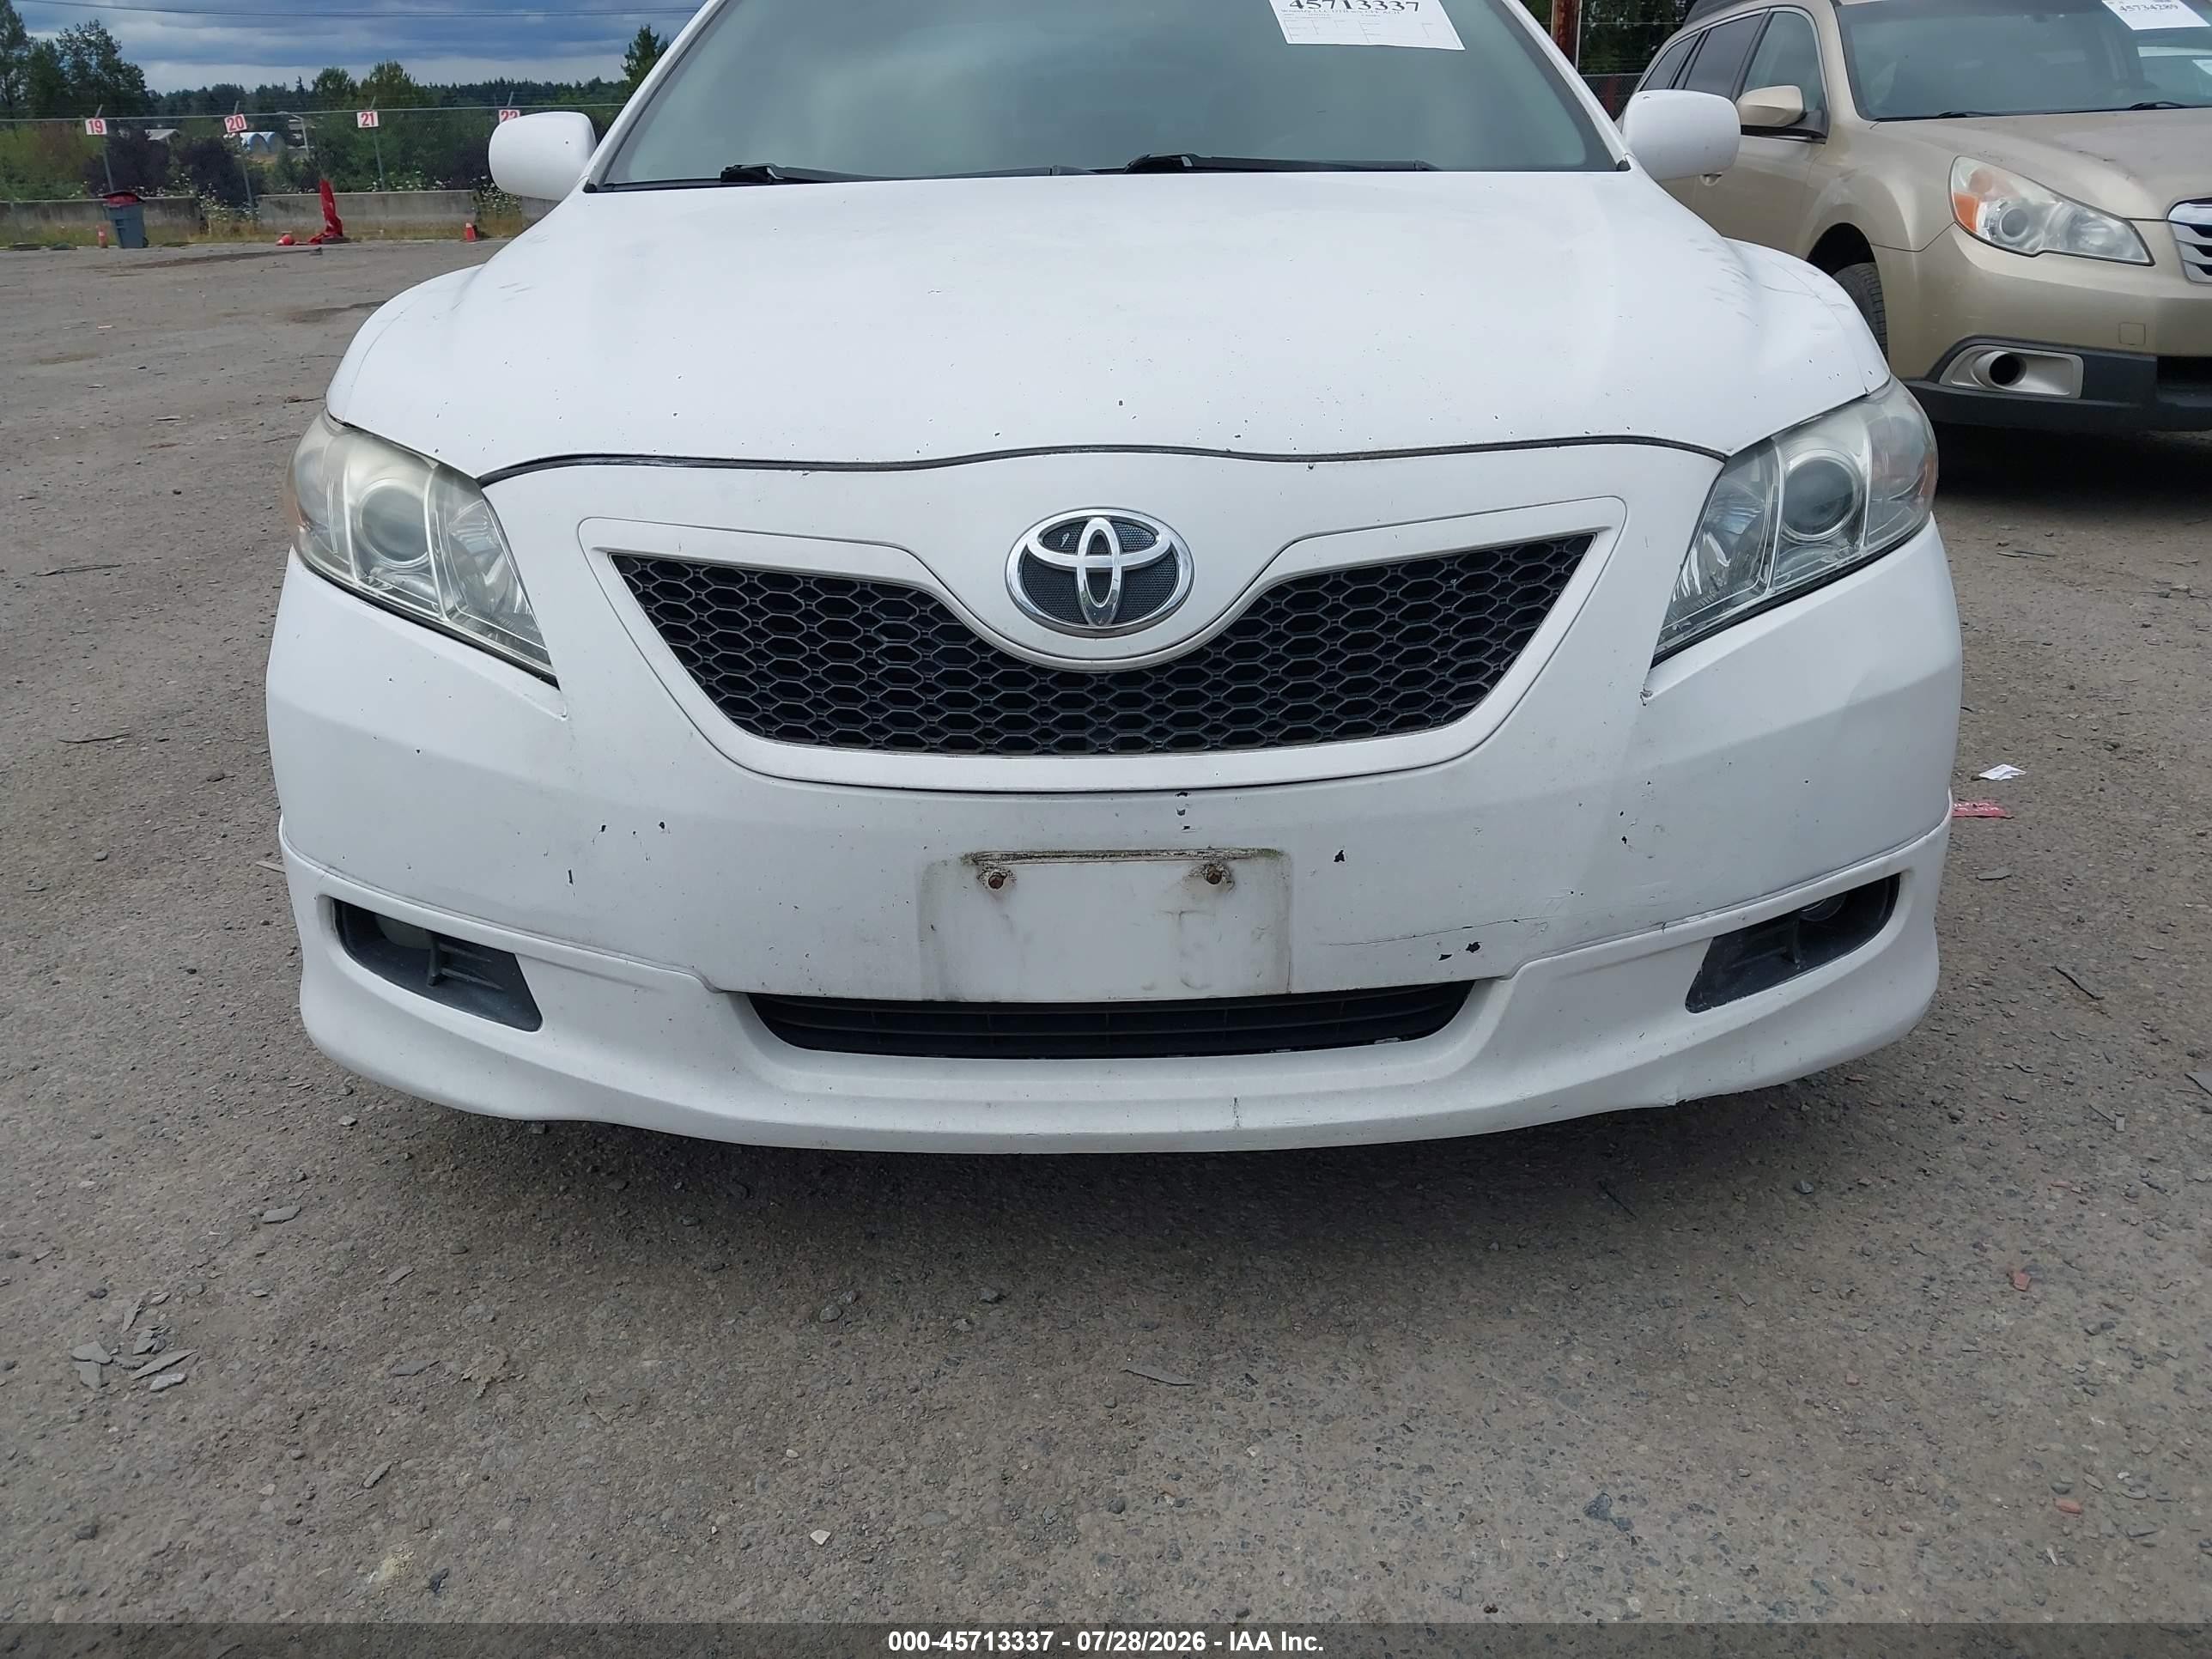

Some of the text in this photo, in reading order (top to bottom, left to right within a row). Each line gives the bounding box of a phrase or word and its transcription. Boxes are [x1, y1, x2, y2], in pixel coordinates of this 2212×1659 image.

[1289, 0, 1419, 12] 45713337
[226, 116, 245, 131] 20
[361, 112, 375, 126] 21
[88, 119, 104, 134] 19
